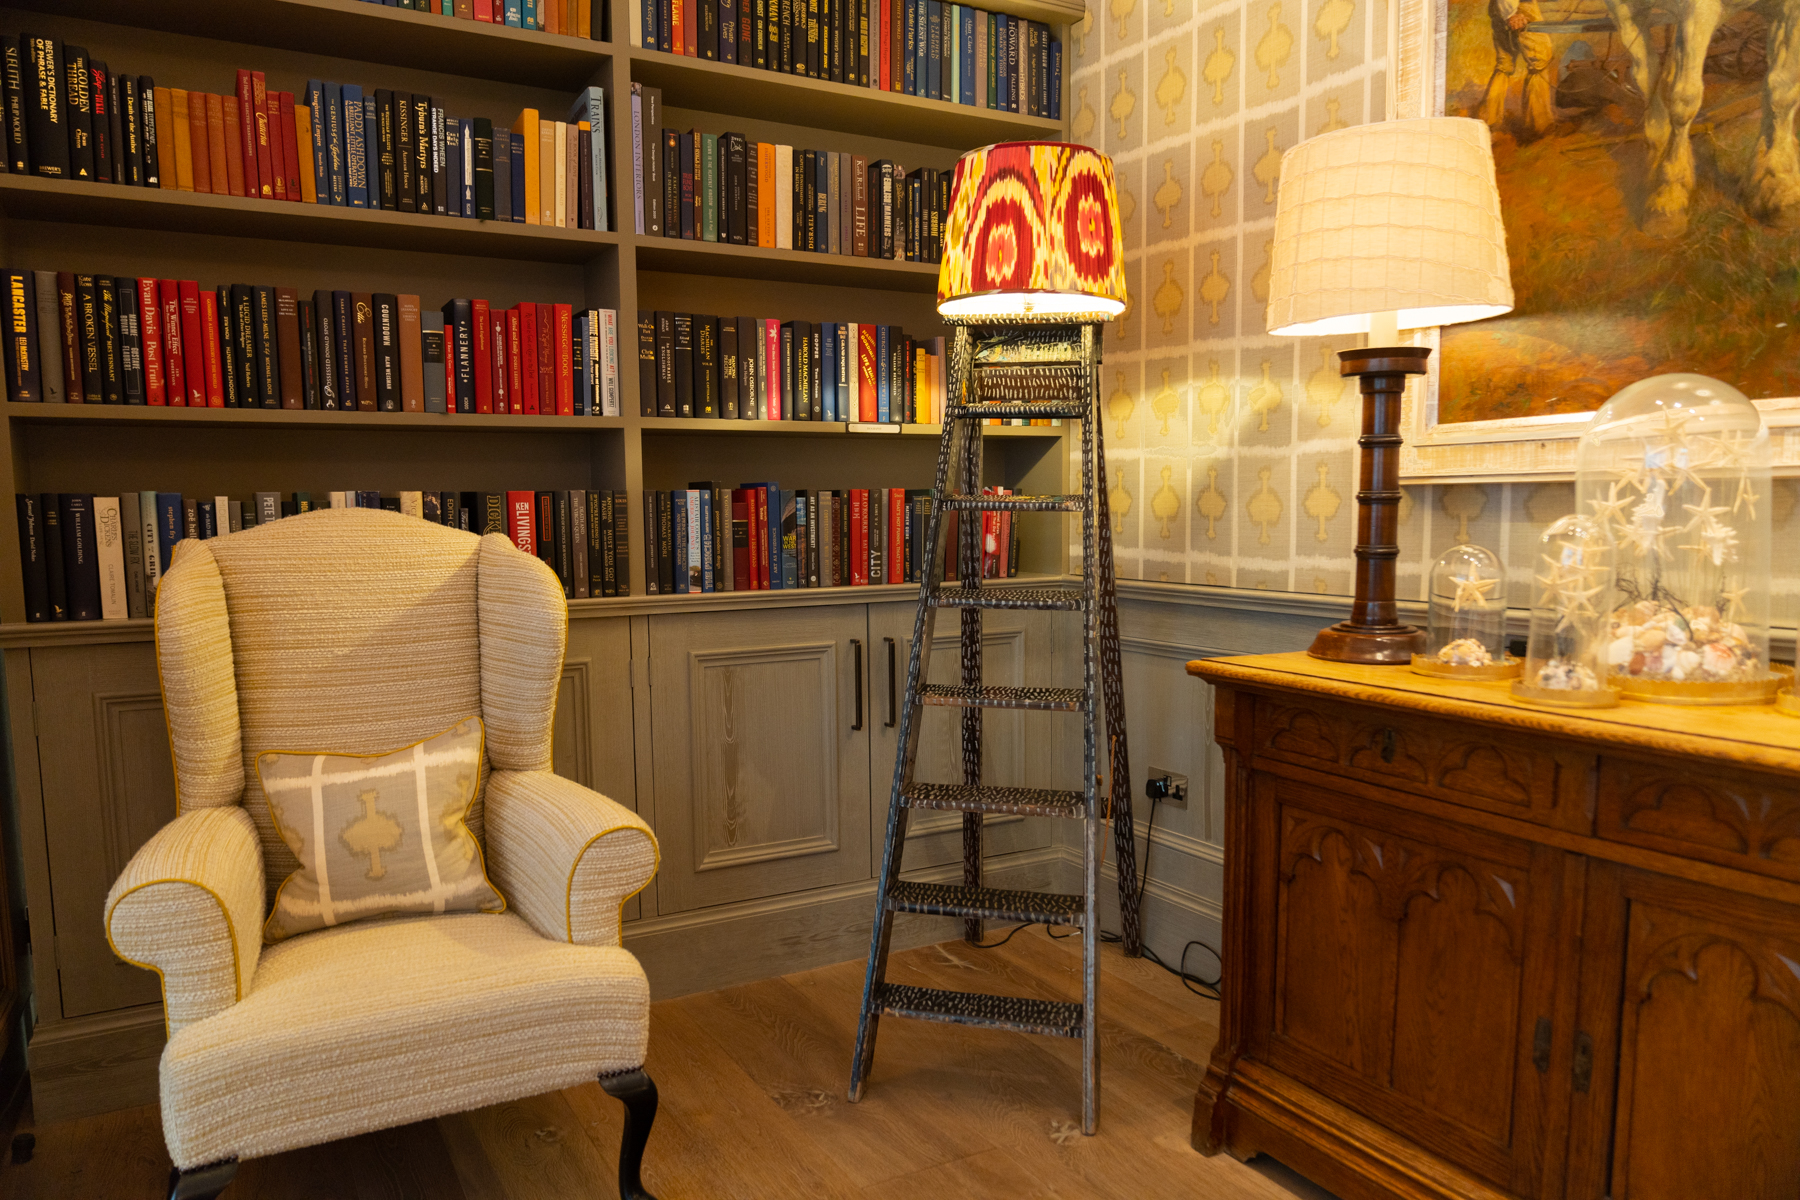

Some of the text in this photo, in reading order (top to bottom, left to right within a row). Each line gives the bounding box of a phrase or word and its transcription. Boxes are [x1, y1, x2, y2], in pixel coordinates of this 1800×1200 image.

[672, 0, 680, 26] FLAME
[36, 39, 44, 49] OF
[742, 18, 751, 43] GONE
[37, 50, 46, 79] PHRASE
[5, 47, 20, 89] SLEUTH
[13, 116, 22, 144] MOULD
[45, 40, 58, 124] BREWER'S DICTIONARY
[67, 62, 79, 105] THREAD
[78, 69, 89, 113] GOLDEN
[40, 89, 48, 110] FABLE
[399, 100, 408, 142] KISSINGER
[415, 102, 429, 169] Tyburn's Martyrs
[437, 108, 445, 139] FRANCIS
[354, 101, 366, 188] PADDY ASHDOWN
[633, 111, 643, 199] LONDON INTERIORS
[856, 177, 864, 201] Richards
[855, 206, 866, 237] LIFE
[883, 205, 892, 237] MANNERS
[10, 275, 26, 333] LANCASTER
[83, 303, 95, 339] BROKEN
[129, 314, 138, 336] MADAME
[143, 280, 160, 389] Evan Davis Post Truth
[381, 304, 391, 346] COUNTDOWN
[244, 325, 252, 358] DREAMER
[459, 327, 470, 379] FLANNERY
[87, 342, 97, 373] VESSEL
[122, 346, 131, 371] FLAUBERT
[131, 347, 140, 370] GUSTAVE
[188, 508, 196, 522] zoë
[264, 497, 275, 516] PETE
[516, 502, 529, 511] KEN
[100, 516, 111, 548] DICKENS
[107, 508, 118, 541] CHARLES
[128, 531, 138, 540] THE
[166, 506, 176, 540] stephen fry
[129, 541, 139, 555] SLOW
[871, 550, 880, 578] CITY
